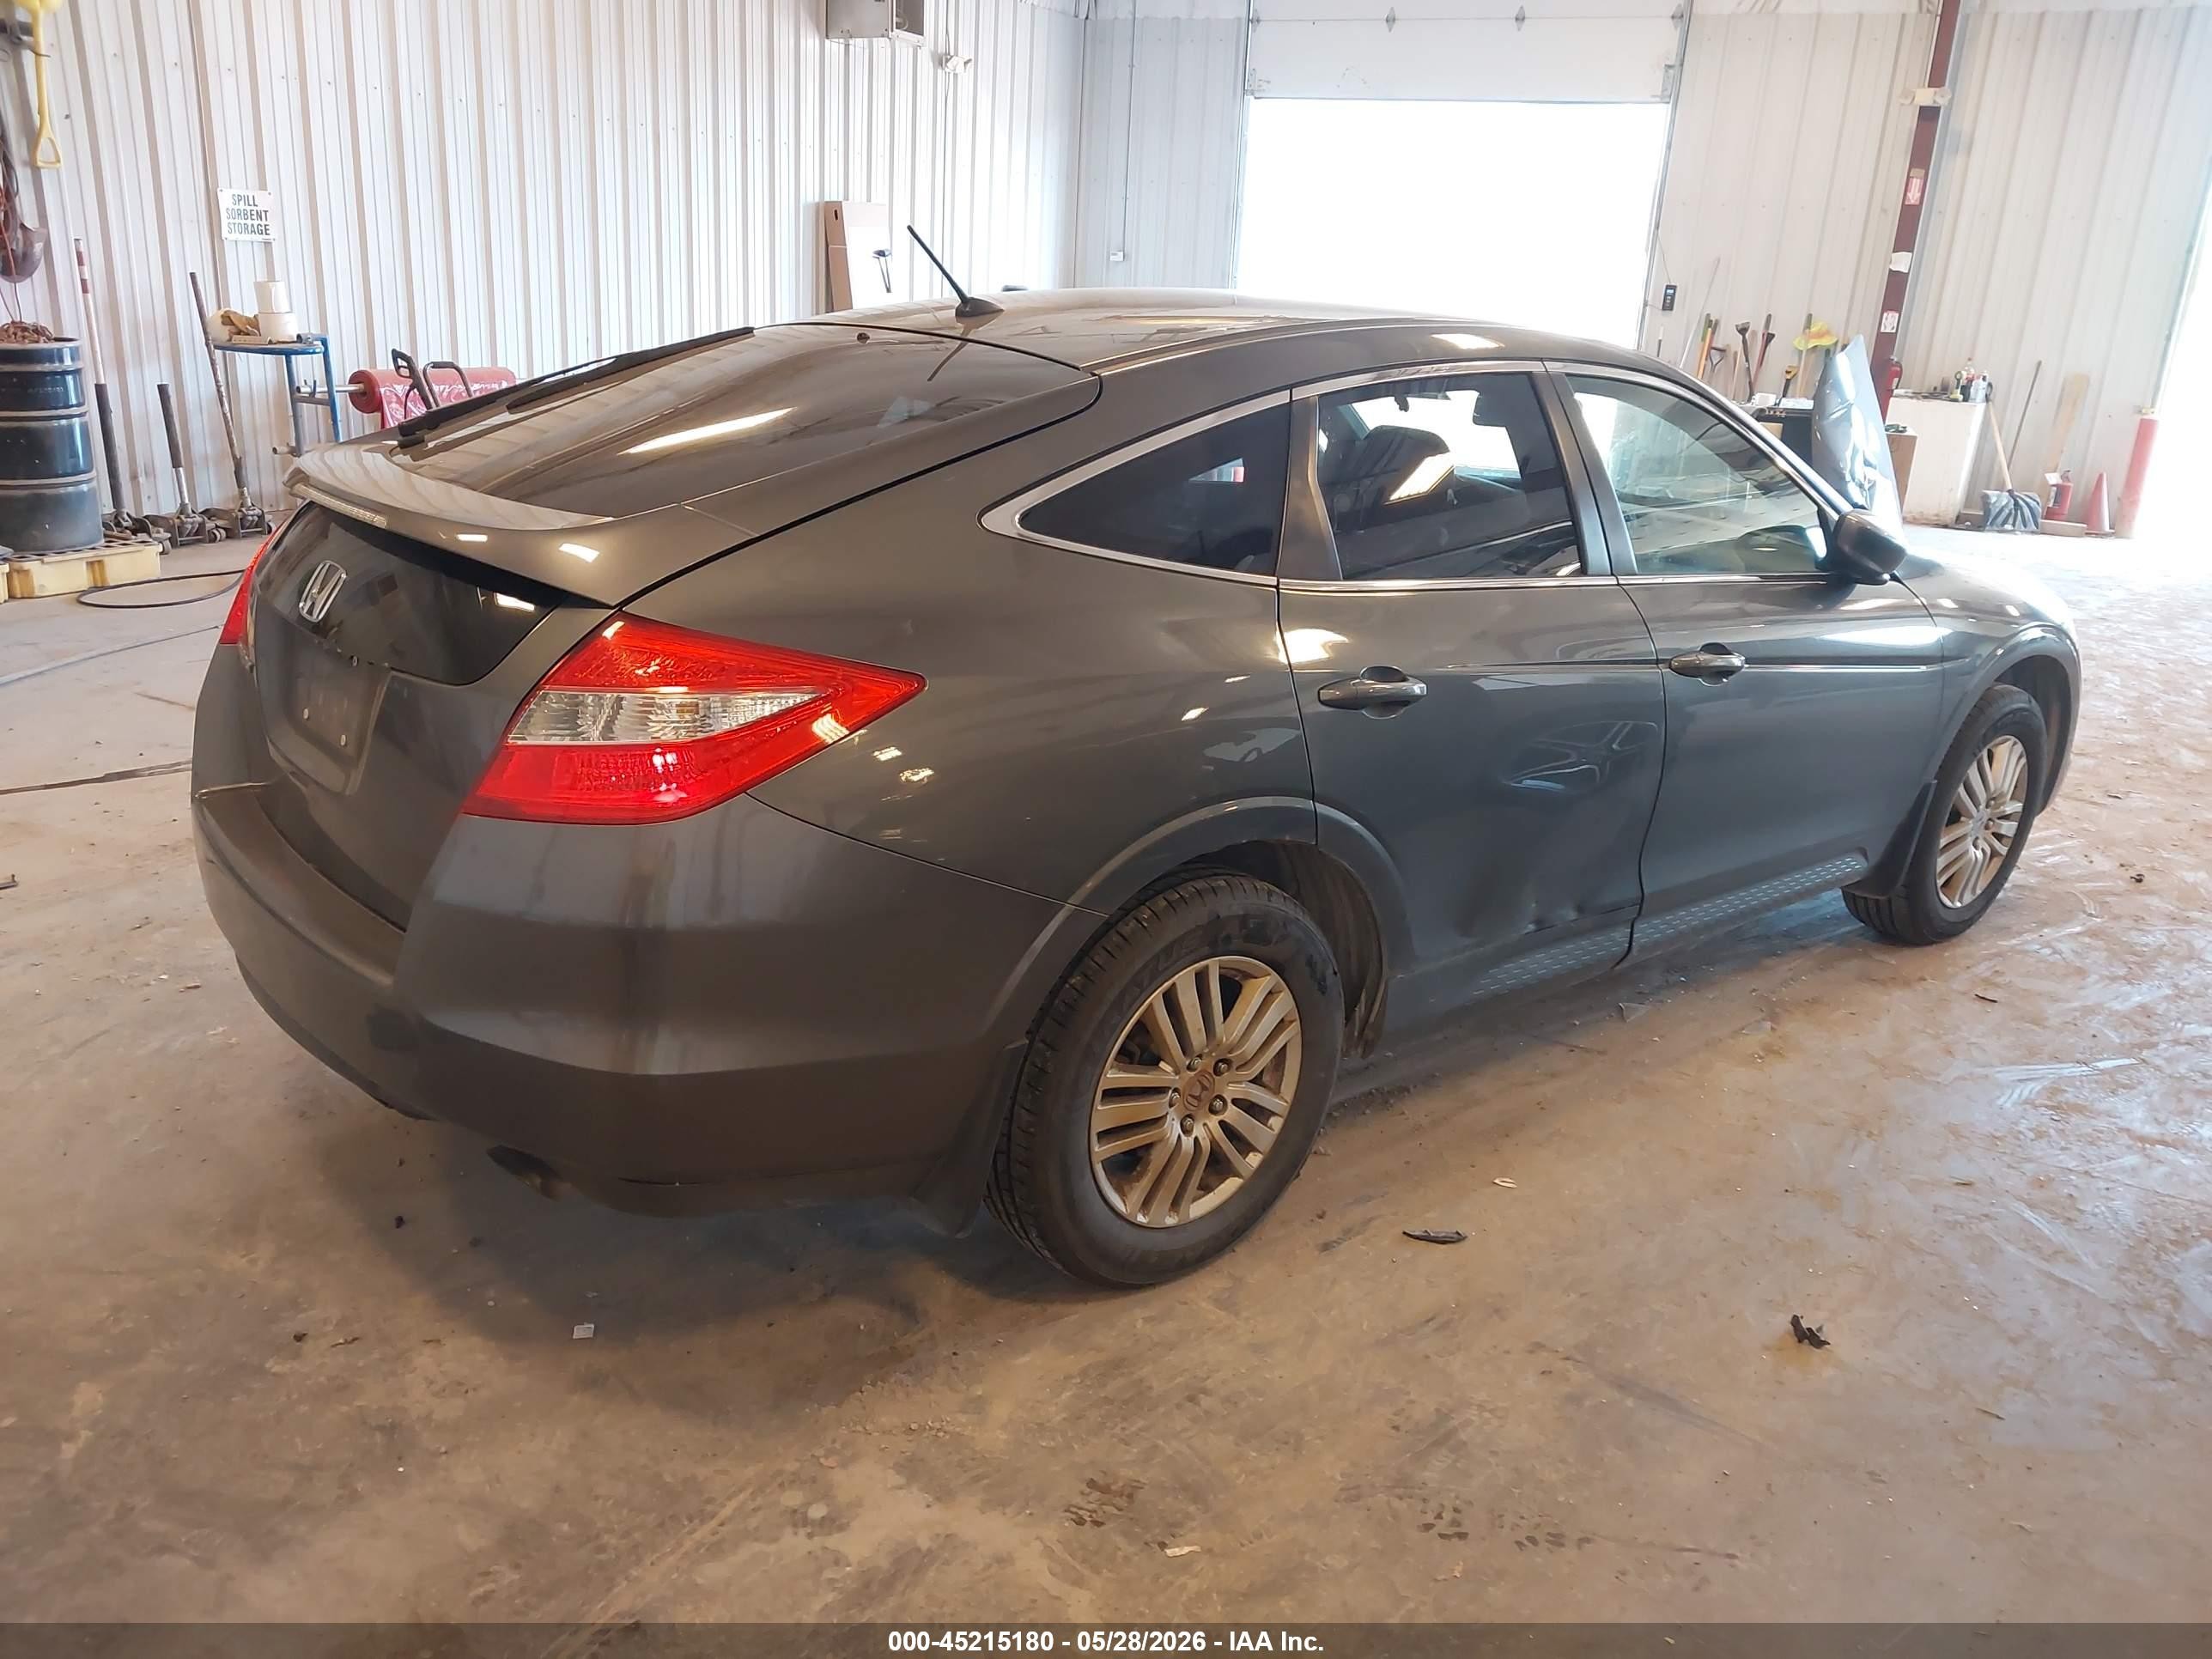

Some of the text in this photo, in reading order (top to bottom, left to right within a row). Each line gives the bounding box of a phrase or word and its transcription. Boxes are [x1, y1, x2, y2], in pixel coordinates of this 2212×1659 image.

[232, 194, 258, 207] SPILL
[226, 208, 269, 222] SORBENT
[228, 222, 270, 236] STORAGE
